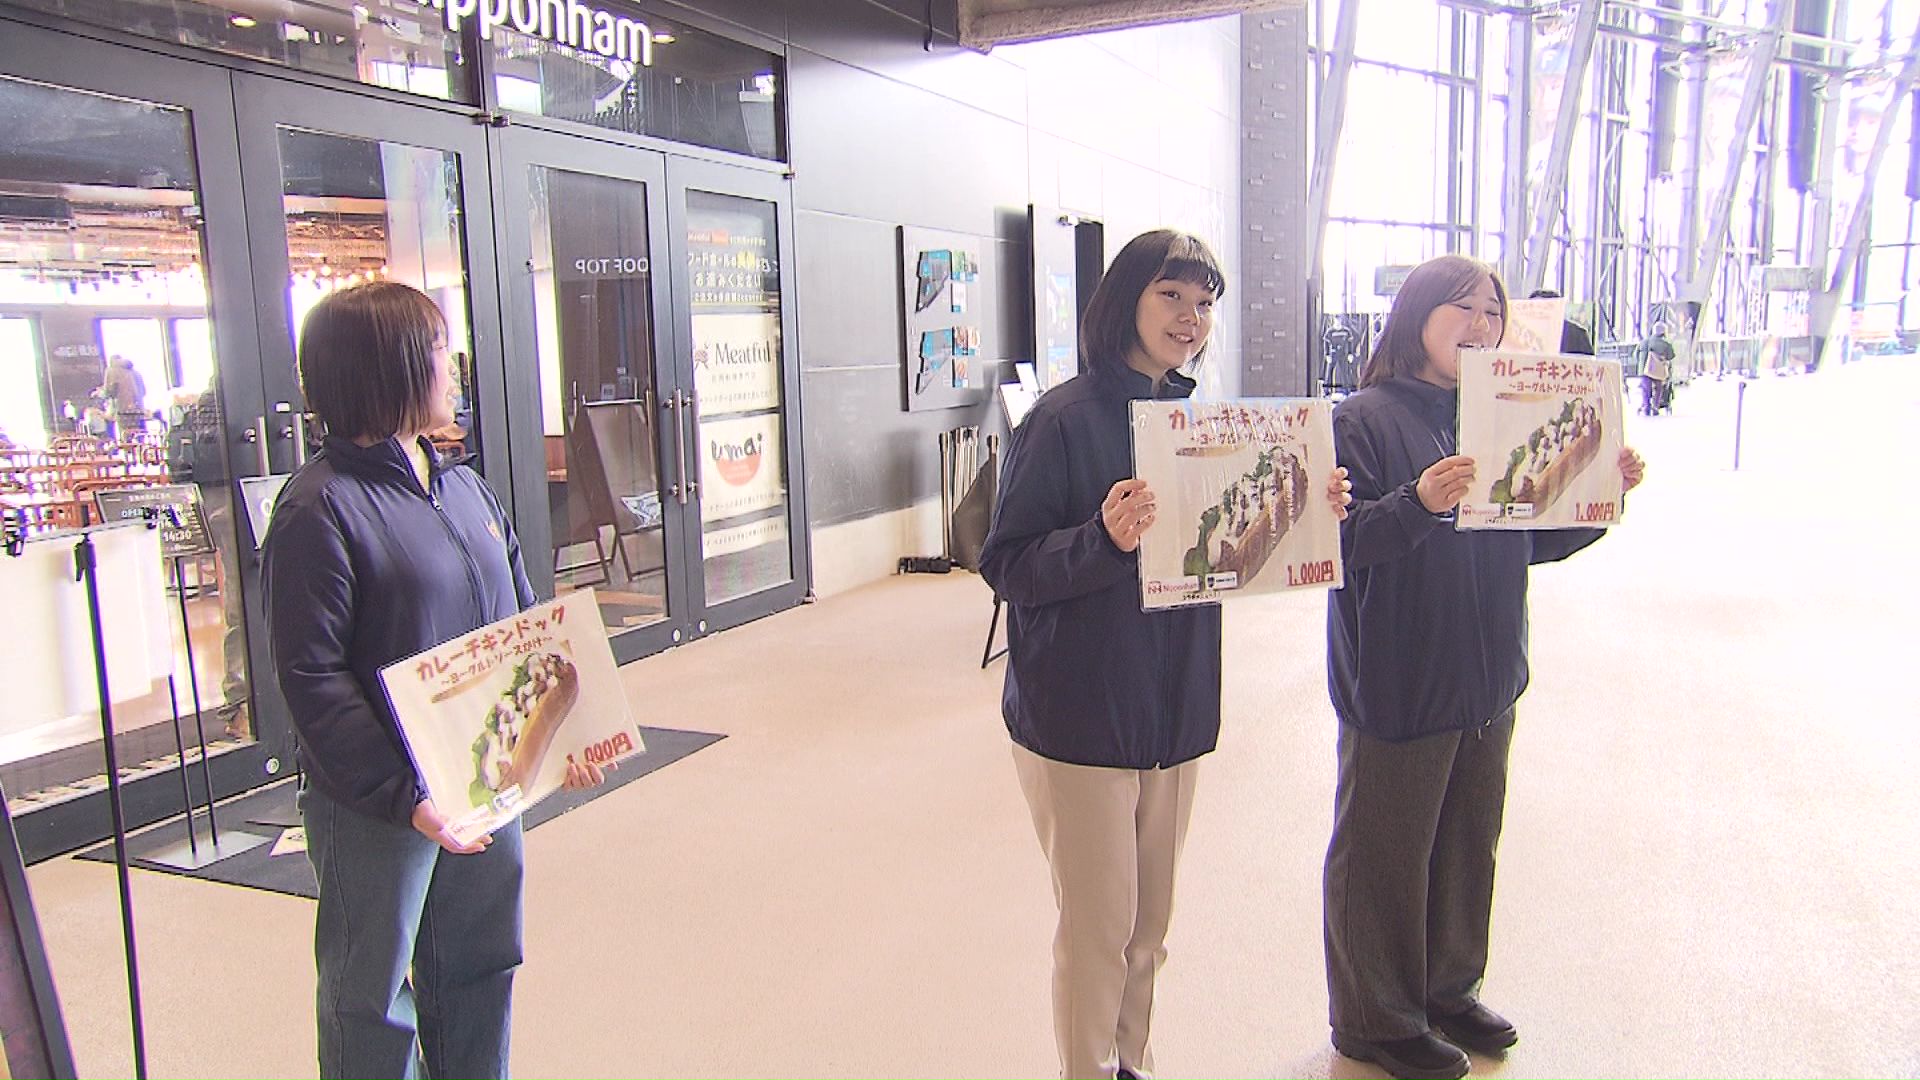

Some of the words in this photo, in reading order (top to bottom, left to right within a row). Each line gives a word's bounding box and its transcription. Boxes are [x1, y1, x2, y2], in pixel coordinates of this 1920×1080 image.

[418, 0, 651, 66] pponham
[715, 340, 771, 366] Meatful
[711, 432, 763, 461] umai
